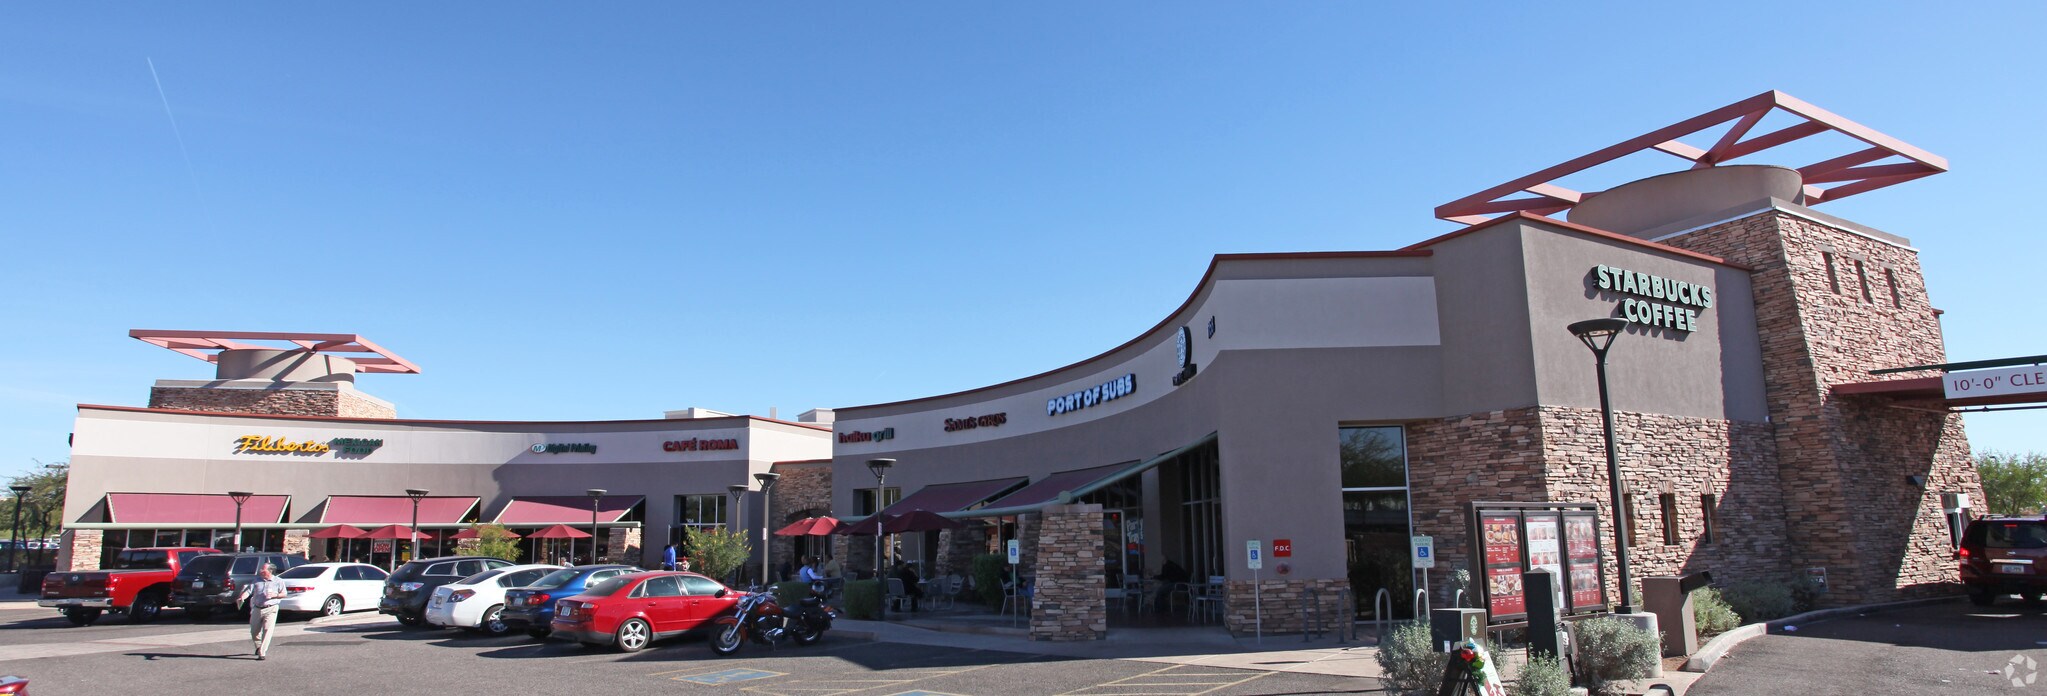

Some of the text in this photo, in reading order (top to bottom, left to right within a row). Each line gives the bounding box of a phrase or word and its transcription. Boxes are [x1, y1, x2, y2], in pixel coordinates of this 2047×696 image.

[1597, 264, 1713, 309] STARBUCKS
[1624, 298, 1697, 332] COFFEE
[1046, 373, 1136, 416] PORT OF SUBS
[663, 437, 739, 452] CAFÉ ROMA
[872, 427, 895, 443] grill
